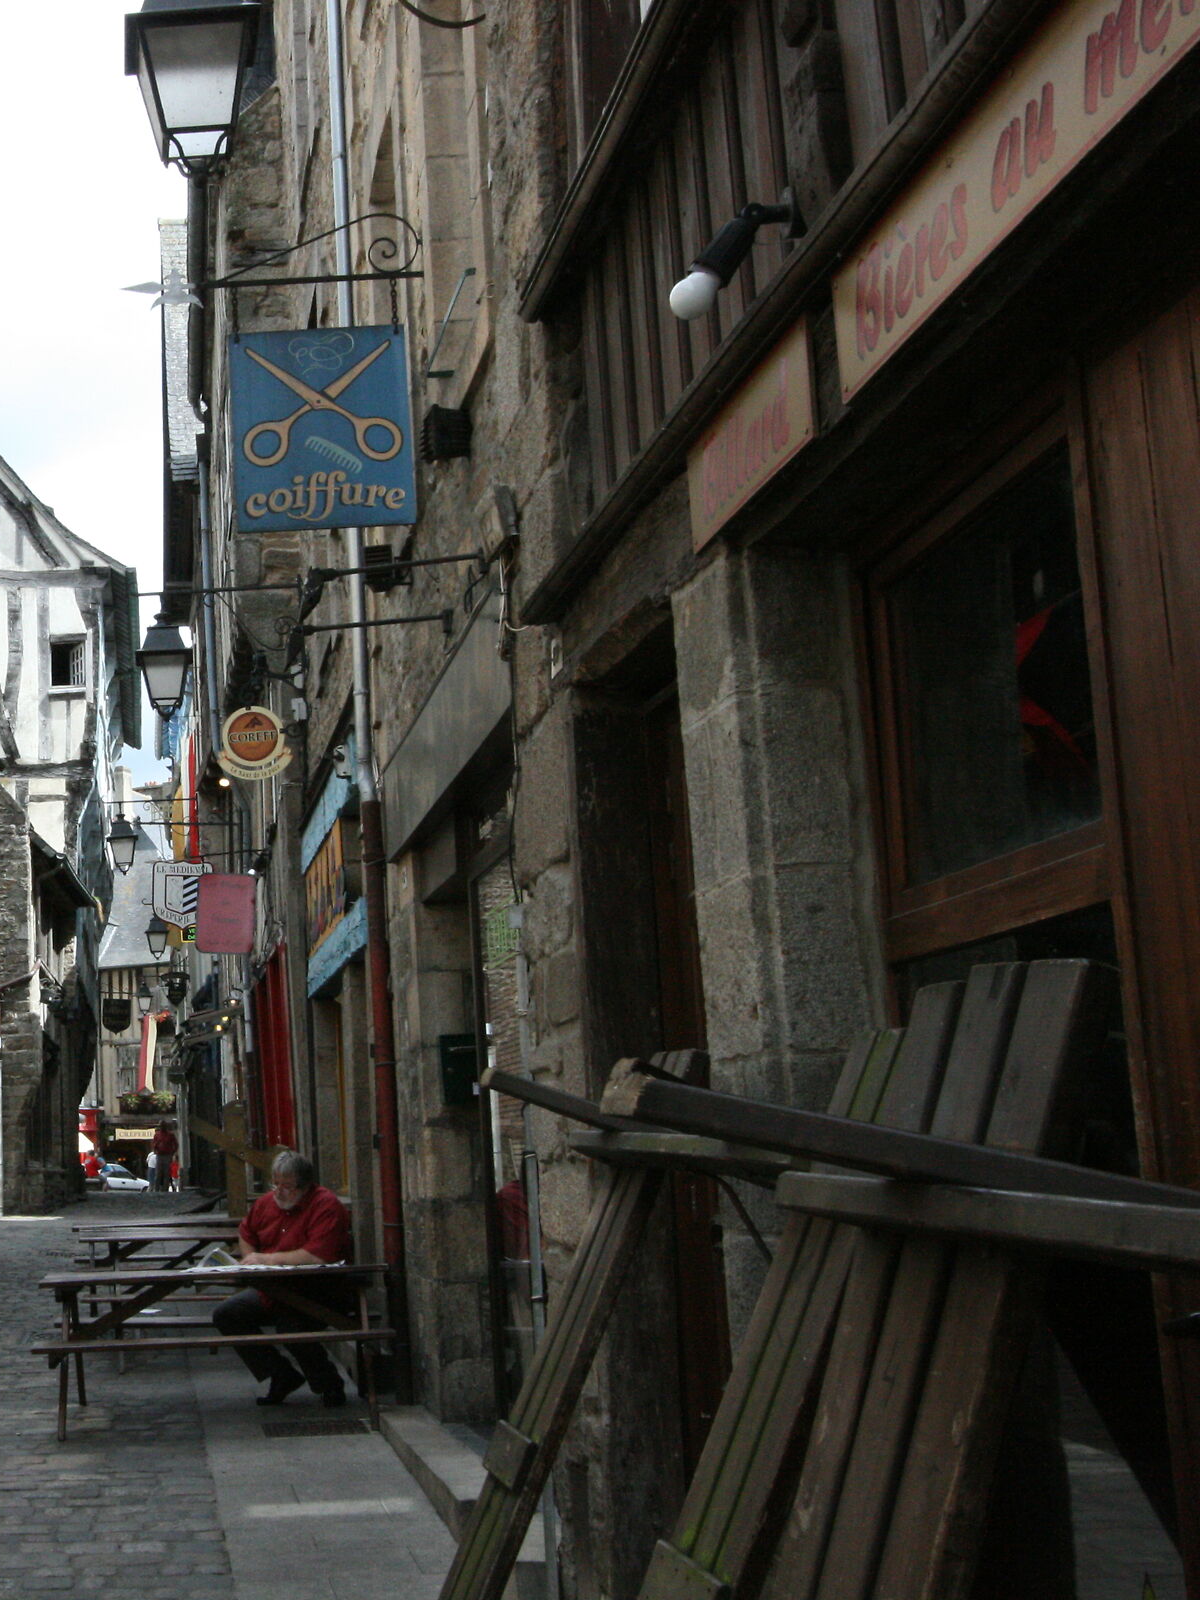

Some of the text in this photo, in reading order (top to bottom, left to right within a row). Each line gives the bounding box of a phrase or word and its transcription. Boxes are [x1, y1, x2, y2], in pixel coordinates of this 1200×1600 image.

[990, 81, 1056, 213] au
[246, 470, 406, 522] coiffure
[228, 730, 277, 744] COREFF
